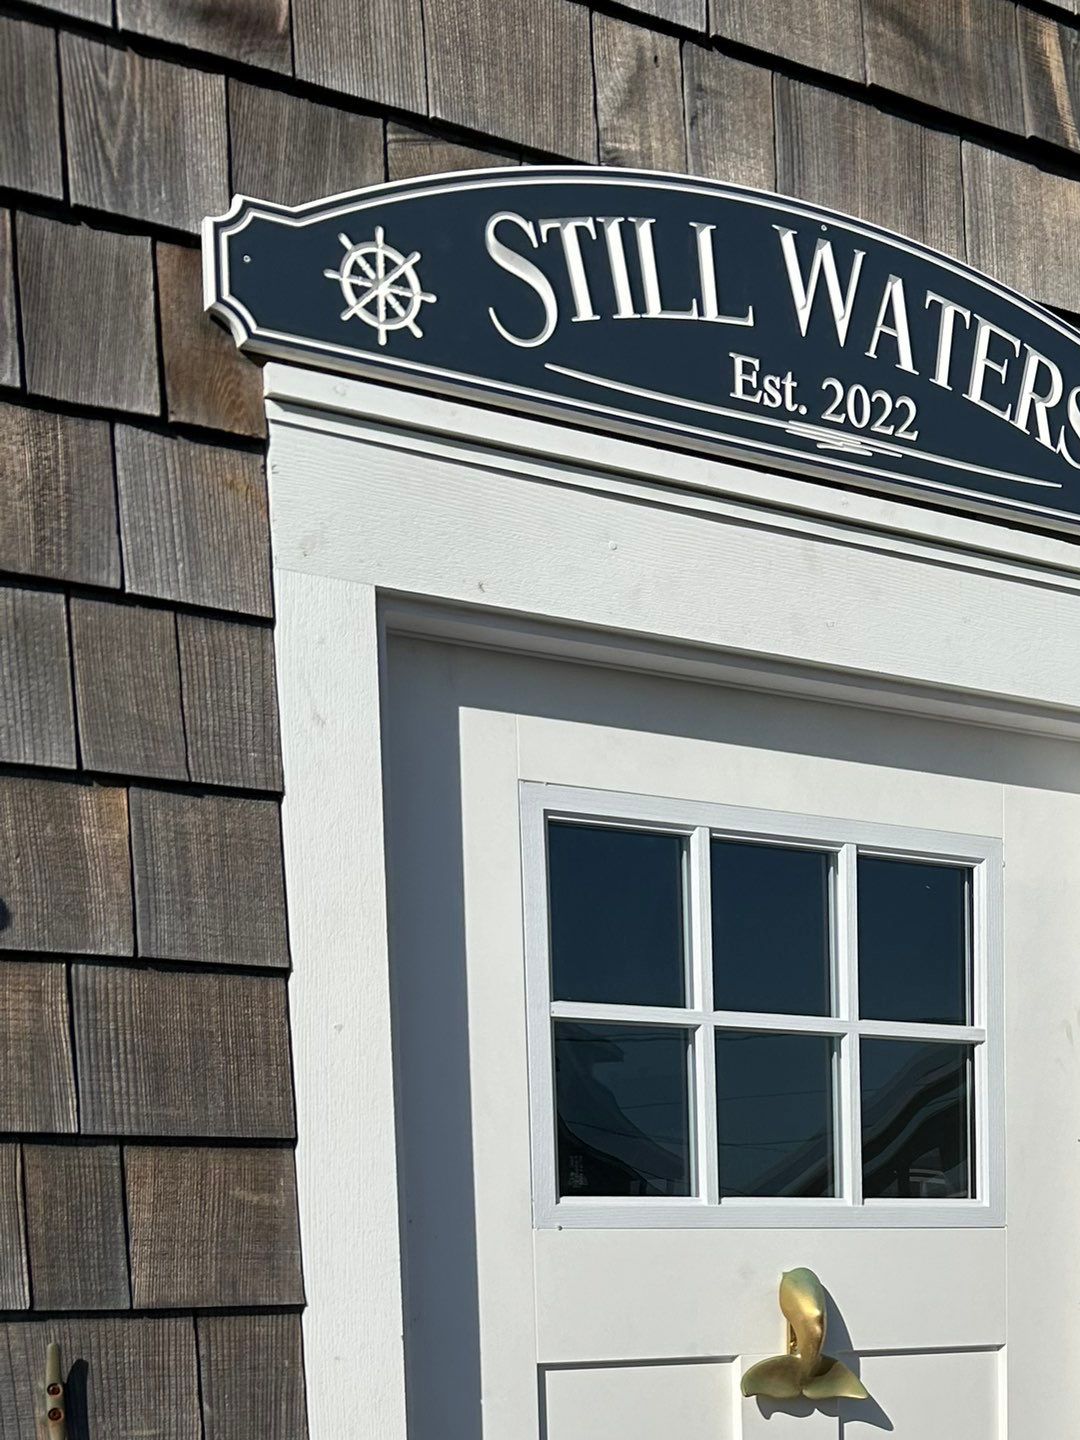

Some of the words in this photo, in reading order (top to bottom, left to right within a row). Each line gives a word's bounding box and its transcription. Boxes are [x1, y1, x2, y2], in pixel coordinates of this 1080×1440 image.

[484, 211, 755, 348] STILL
[728, 351, 808, 416] Est.
[820, 377, 919, 442] 2022
